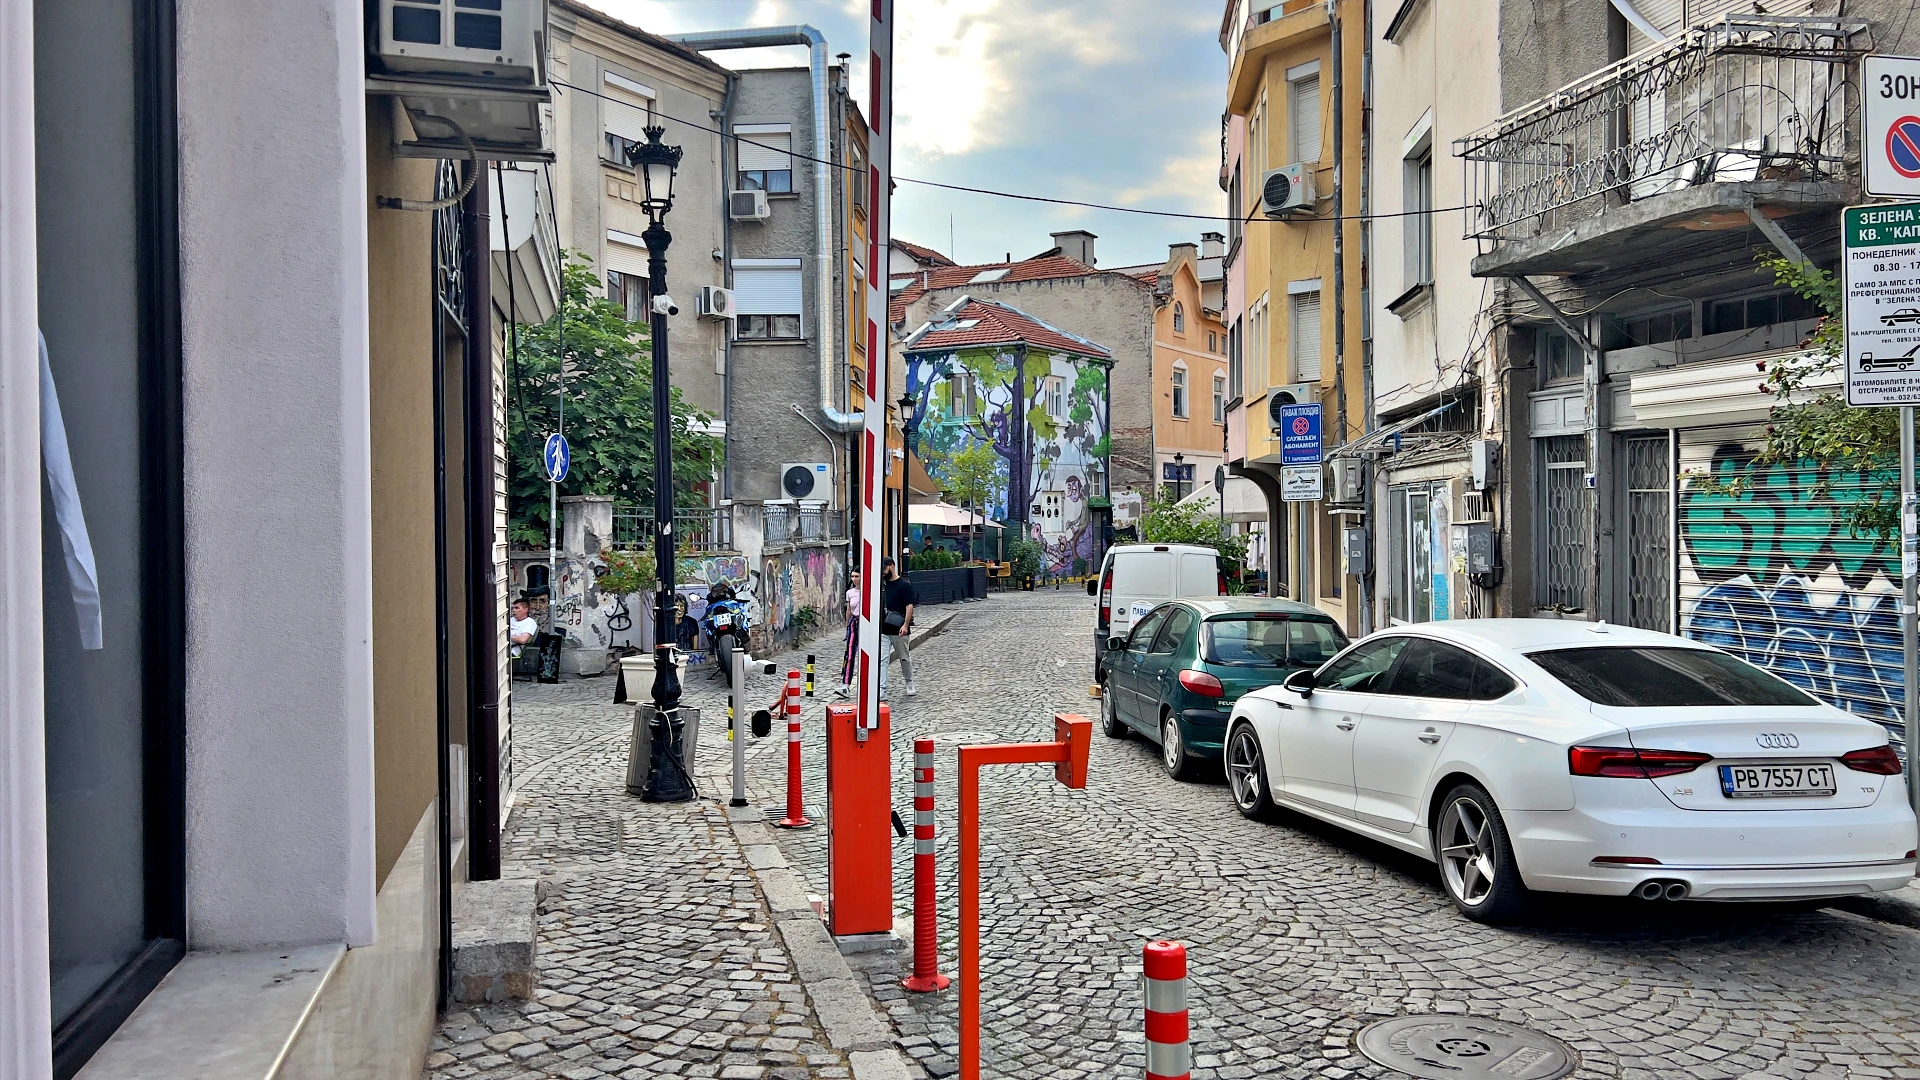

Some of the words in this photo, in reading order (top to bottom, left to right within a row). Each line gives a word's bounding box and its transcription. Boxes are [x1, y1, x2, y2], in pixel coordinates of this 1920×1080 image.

[1880, 74, 1920, 99] ЗОН
[1859, 209, 1914, 225] ЗЕЛЕНА
[1859, 229, 1881, 241] КВ.
[1852, 248, 1916, 260] ПОНЕДЕЛНИК
[1873, 262, 1900, 272] 08.30
[1860, 328, 1907, 336] НАРУШИТЕЛИТЕ
[1852, 378, 1907, 387] АВТОМОБИЛИТЕ
[1858, 387, 1904, 395] ОТСТРАНЯВАТ
[1284, 442, 1319, 450] АБОНАМЕНТ
[1734, 769, 1760, 789] PB
[1761, 768, 1803, 788] 7557
[1807, 768, 1829, 787] CT
